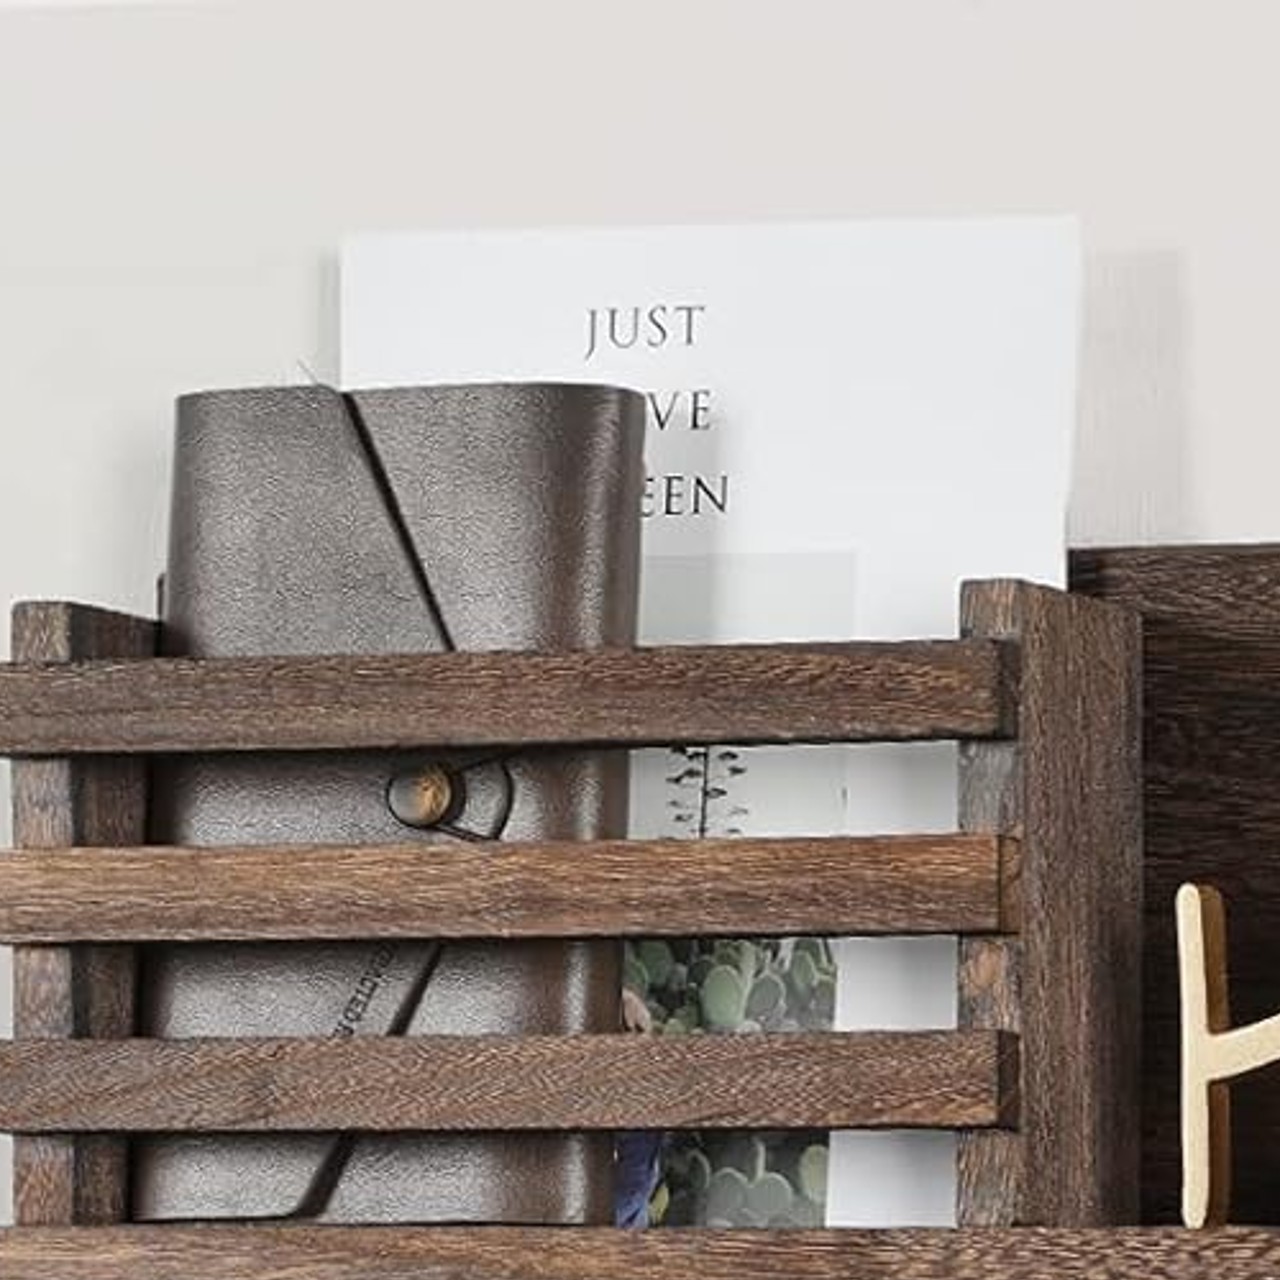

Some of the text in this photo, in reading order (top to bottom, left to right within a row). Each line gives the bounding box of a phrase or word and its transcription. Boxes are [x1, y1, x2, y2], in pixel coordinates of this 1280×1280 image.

[585, 304, 706, 361] JUST
[646, 389, 712, 431] VE
[640, 474, 728, 517] EEN
